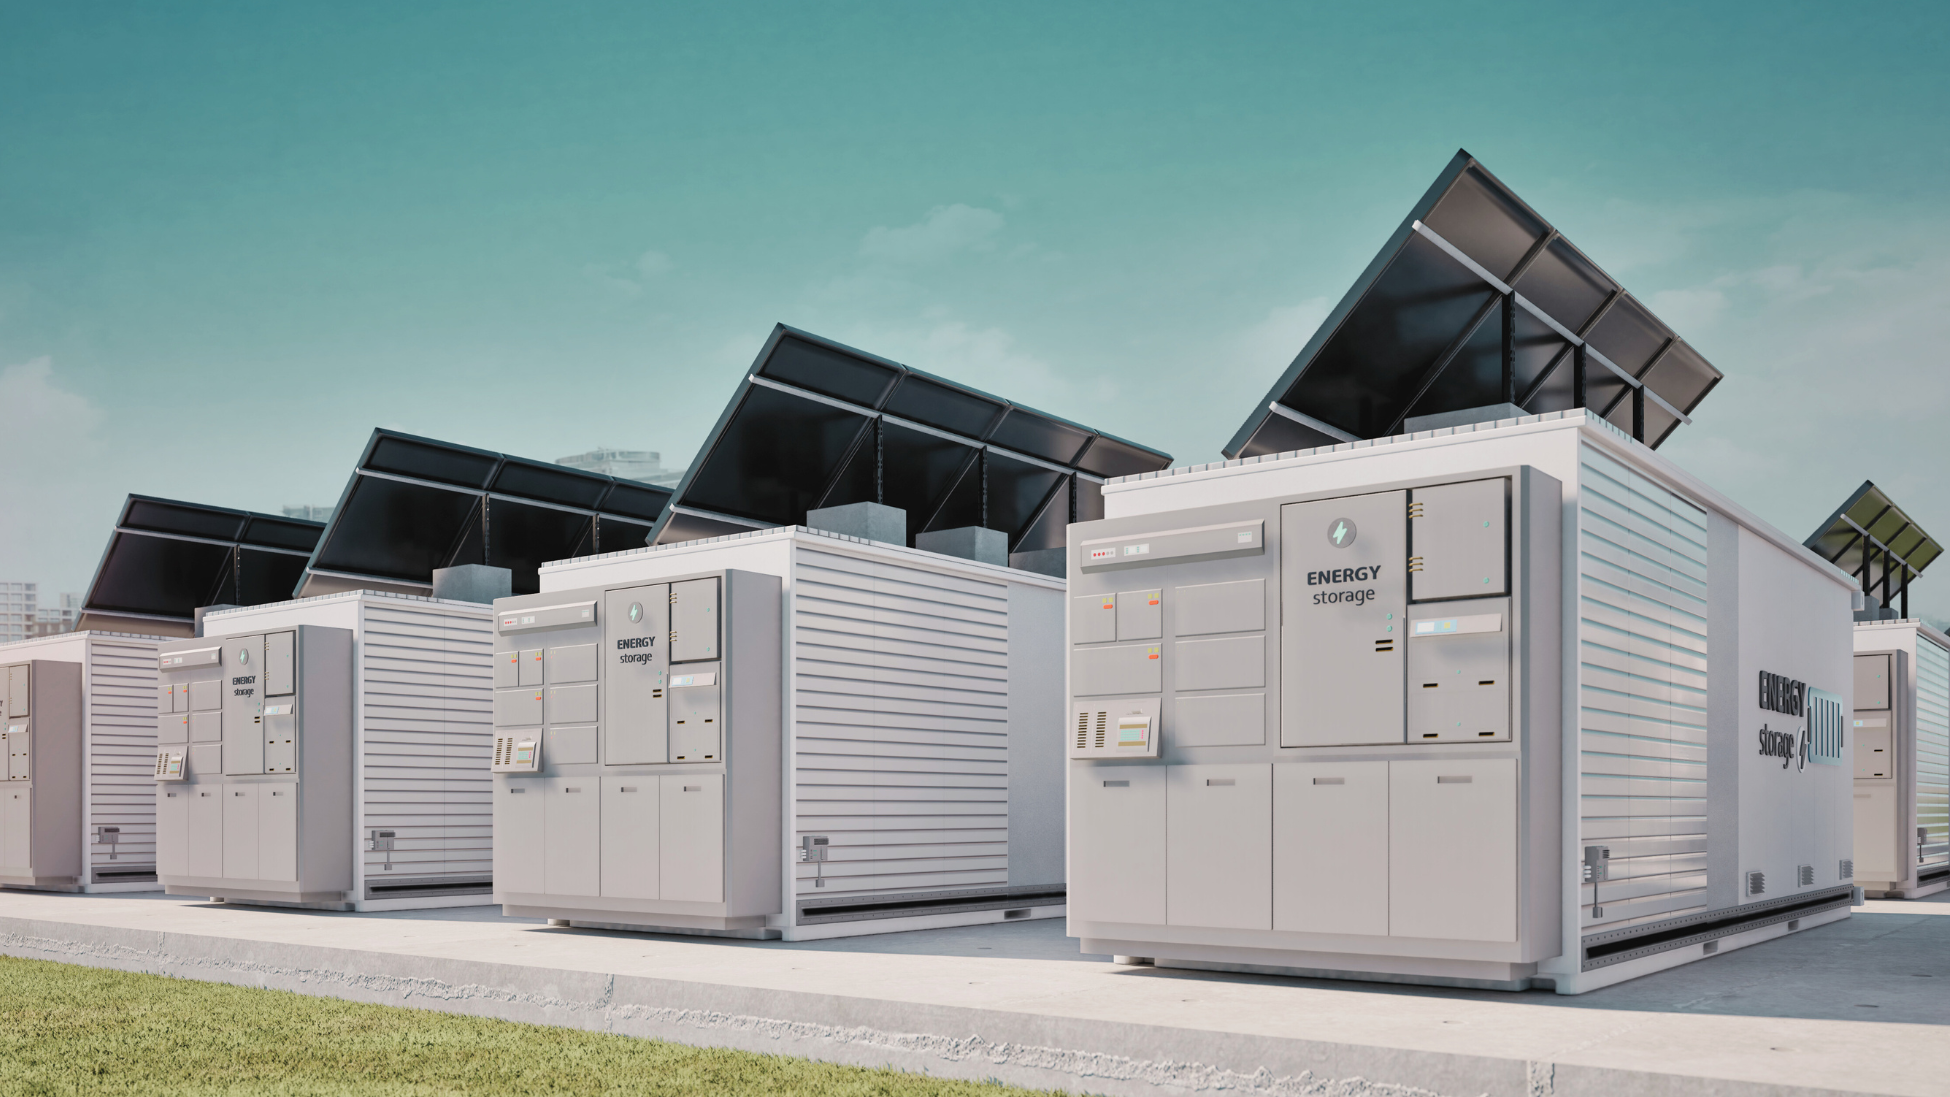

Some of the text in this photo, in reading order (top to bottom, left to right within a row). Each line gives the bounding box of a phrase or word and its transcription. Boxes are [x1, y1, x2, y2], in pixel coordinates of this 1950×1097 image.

[1307, 564, 1382, 586] ENERGY
[1313, 588, 1375, 606] storage
[617, 636, 655, 649] ENERGY
[620, 653, 652, 665] storage
[233, 675, 256, 685] ENERGY
[234, 688, 254, 698] storage
[1758, 669, 1807, 718] ENERGY
[1758, 723, 1795, 770] storage
